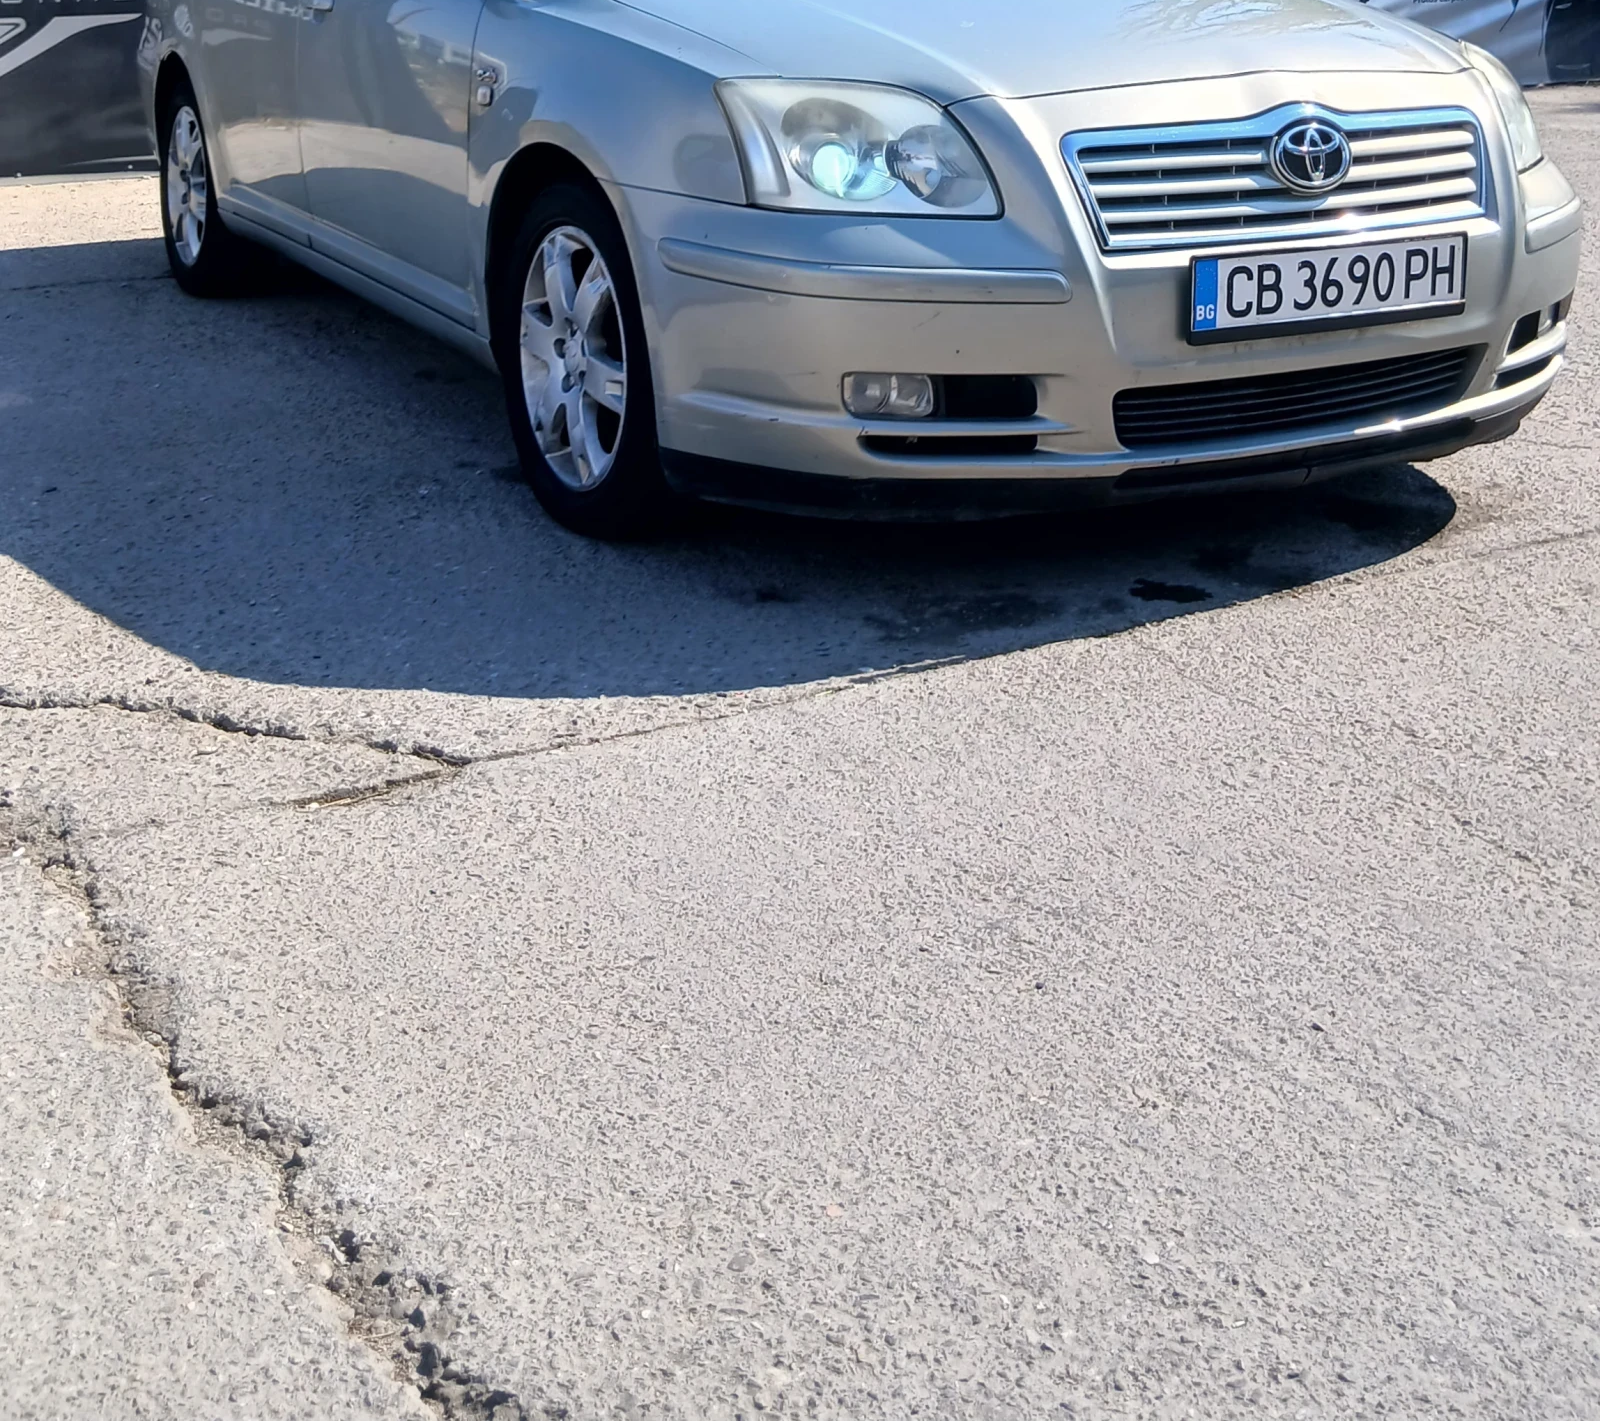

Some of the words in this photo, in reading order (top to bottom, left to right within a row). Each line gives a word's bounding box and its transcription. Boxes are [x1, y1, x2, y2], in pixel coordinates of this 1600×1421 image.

[1226, 263, 1283, 318] CB
[1293, 251, 1396, 312] 3690
[1404, 244, 1456, 299] PH
[1196, 305, 1215, 320] BG
